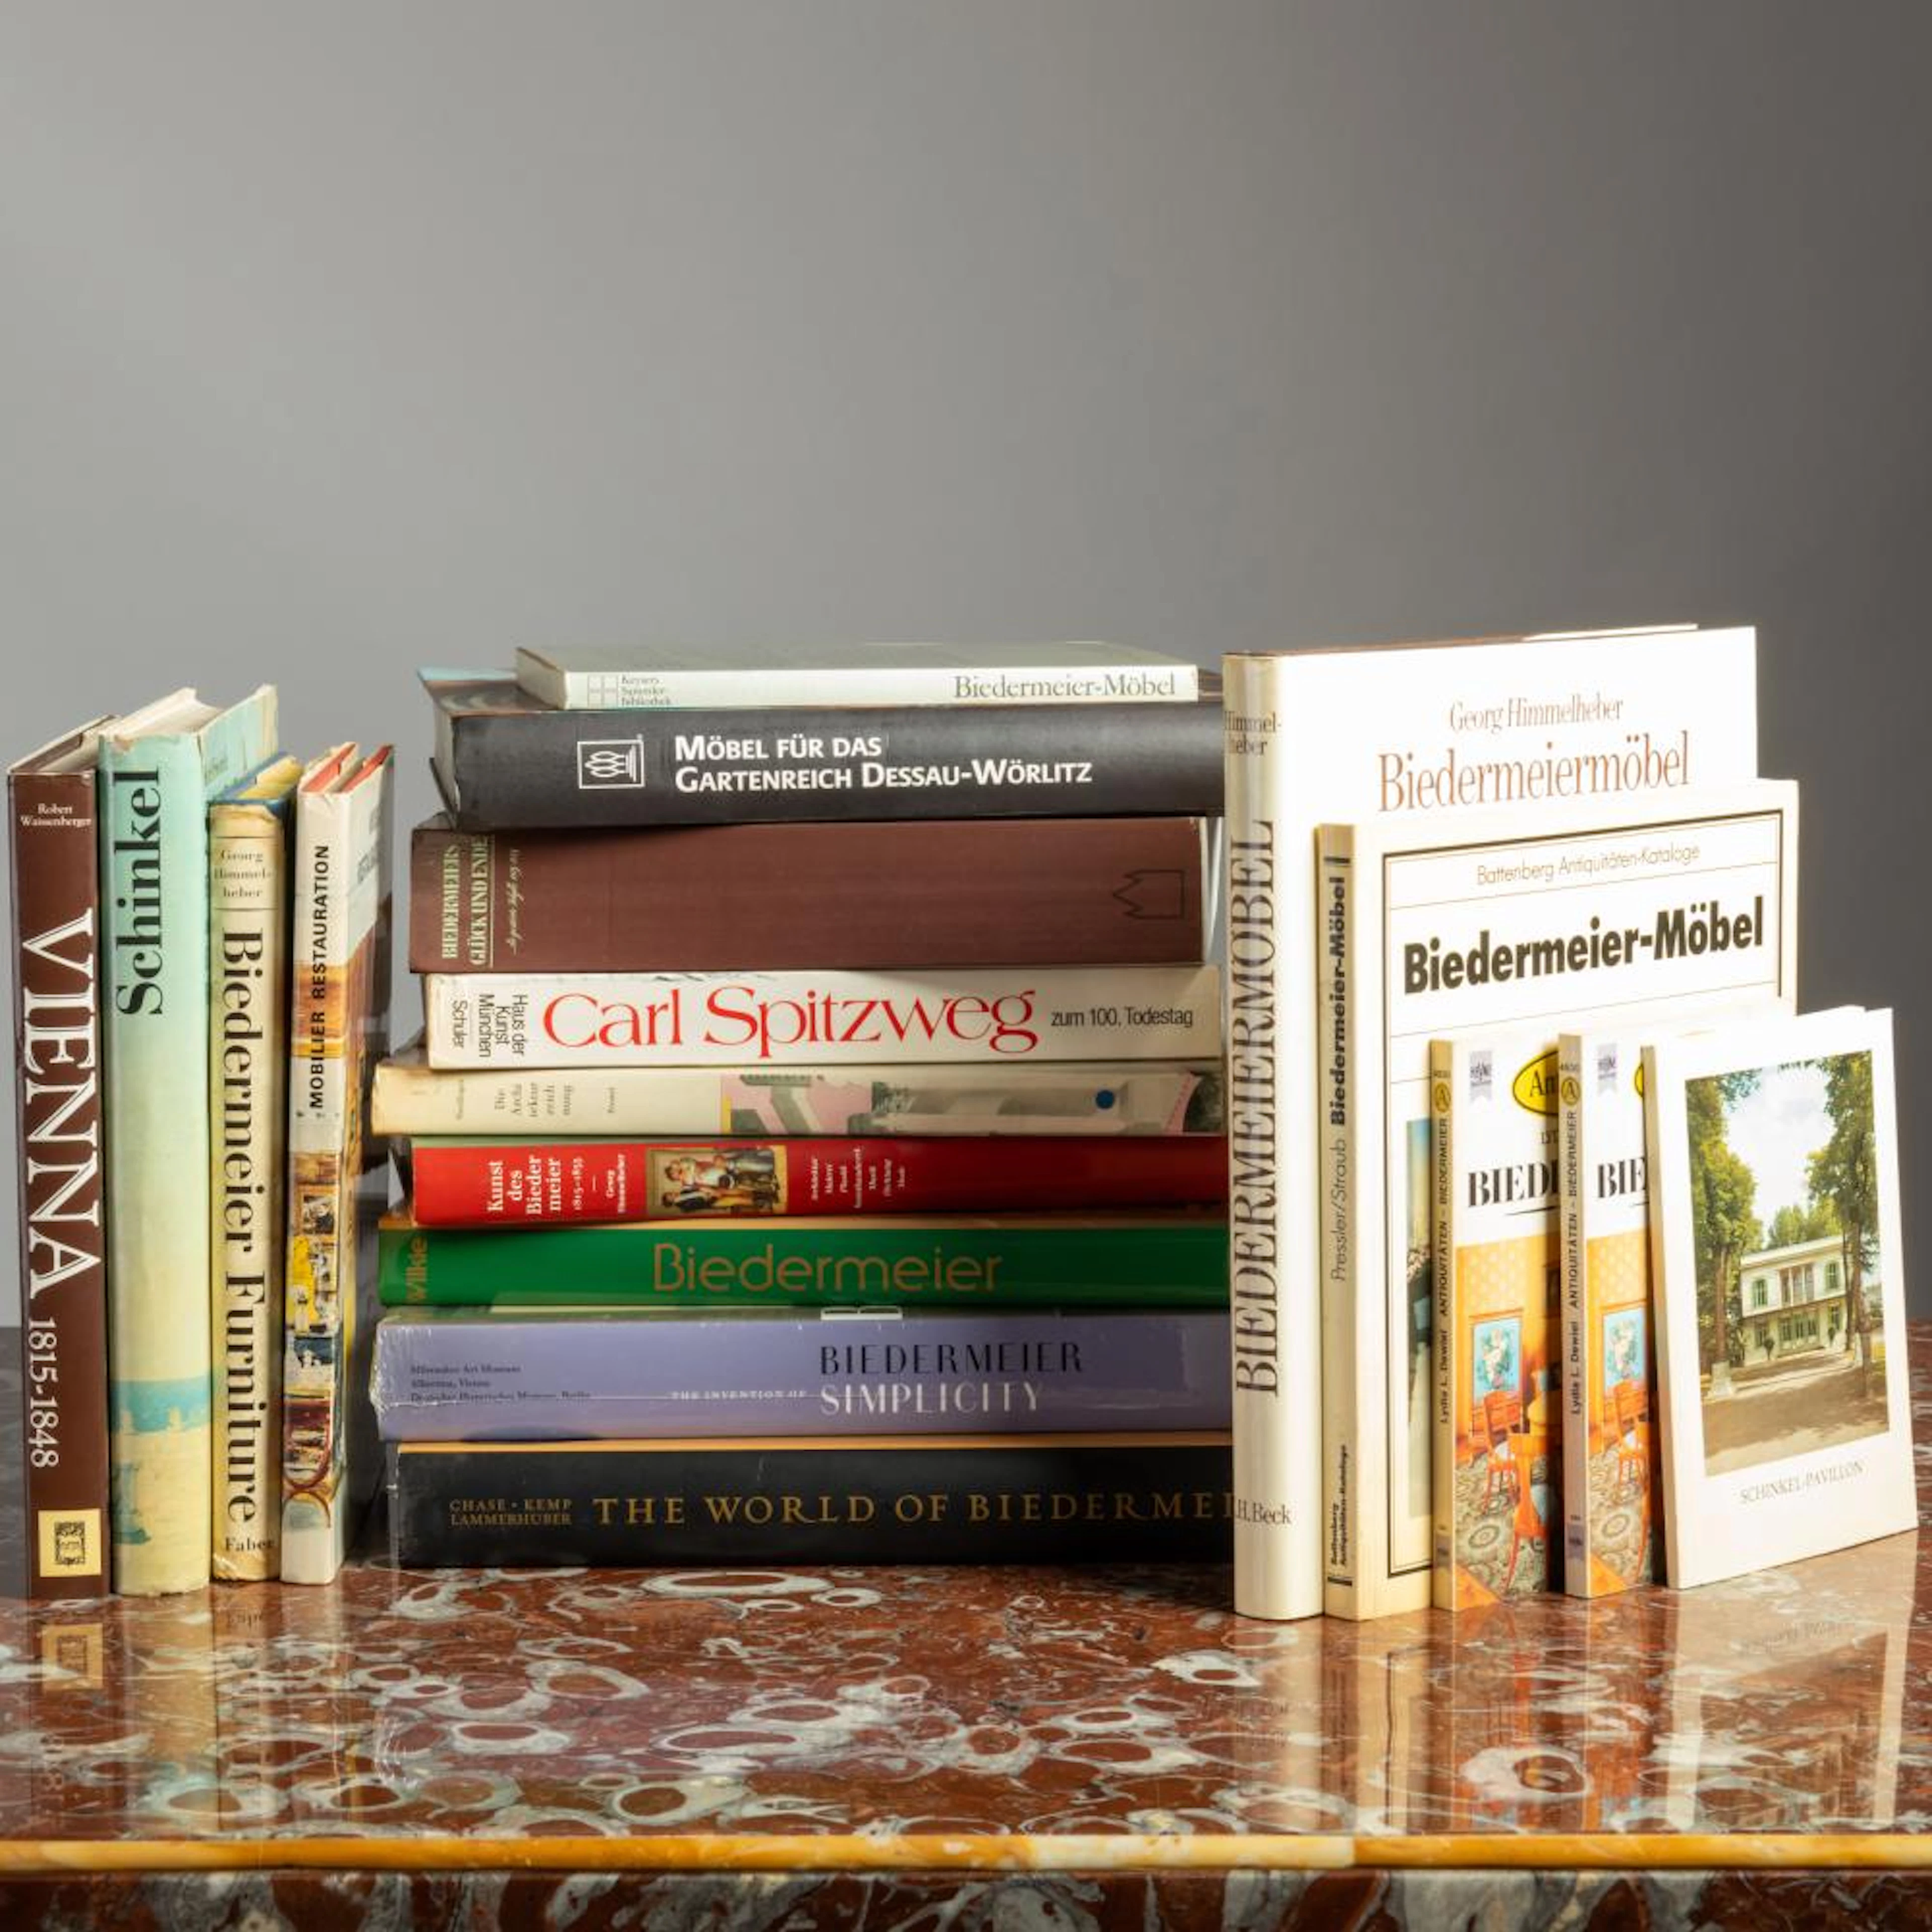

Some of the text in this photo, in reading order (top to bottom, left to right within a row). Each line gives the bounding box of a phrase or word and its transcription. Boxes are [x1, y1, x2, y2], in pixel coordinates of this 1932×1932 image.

[954, 672, 1176, 700] Biedermeier-Möbel
[1451, 692, 1624, 734] Georg Himmelheber
[675, 734, 882, 761] MÖBEL FÜR DAS
[675, 758, 1093, 793] GARTENREICH DESSAU-WÖRLITZ
[1379, 730, 1689, 812] Biedermeiermöbel
[112, 770, 164, 1015] Schinkel
[1477, 844, 1701, 886] Battenberg Antiquitäten-Kataloge
[310, 845, 330, 1000] RESTAURATION
[1404, 895, 1764, 996] Biedermeier-Möbel
[478, 994, 496, 1058] München
[496, 1005, 512, 1045] Kunst
[512, 994, 529, 1056] Haus der
[542, 988, 683, 1048] Carl
[704, 986, 1038, 1059] Spitzweg
[1051, 1010, 1084, 1026] zum
[1126, 1007, 1193, 1029] Todestag
[309, 1011, 326, 1108] MOBILIER
[1329, 876, 1347, 1281] Pressler/Straub Biedermeier-Möbel
[22, 907, 102, 1299] VIENNA
[1231, 820, 1278, 1398] BIEDERMEIERMÖBEL
[487, 1160, 504, 1212] Kunst
[507, 1169, 523, 1202] des
[526, 1155, 543, 1215] Bieder
[546, 1158, 562, 1212] meier
[221, 928, 269, 1523] Biedermeier Furniture
[653, 1242, 1002, 1293] Biedermeier
[820, 1342, 1083, 1376] BIEDERMEIER
[820, 1380, 1044, 1416] SIMPLICITY
[592, 1496, 686, 1525] THE
[704, 1494, 875, 1525] WORLD
[895, 1493, 950, 1523] OF
